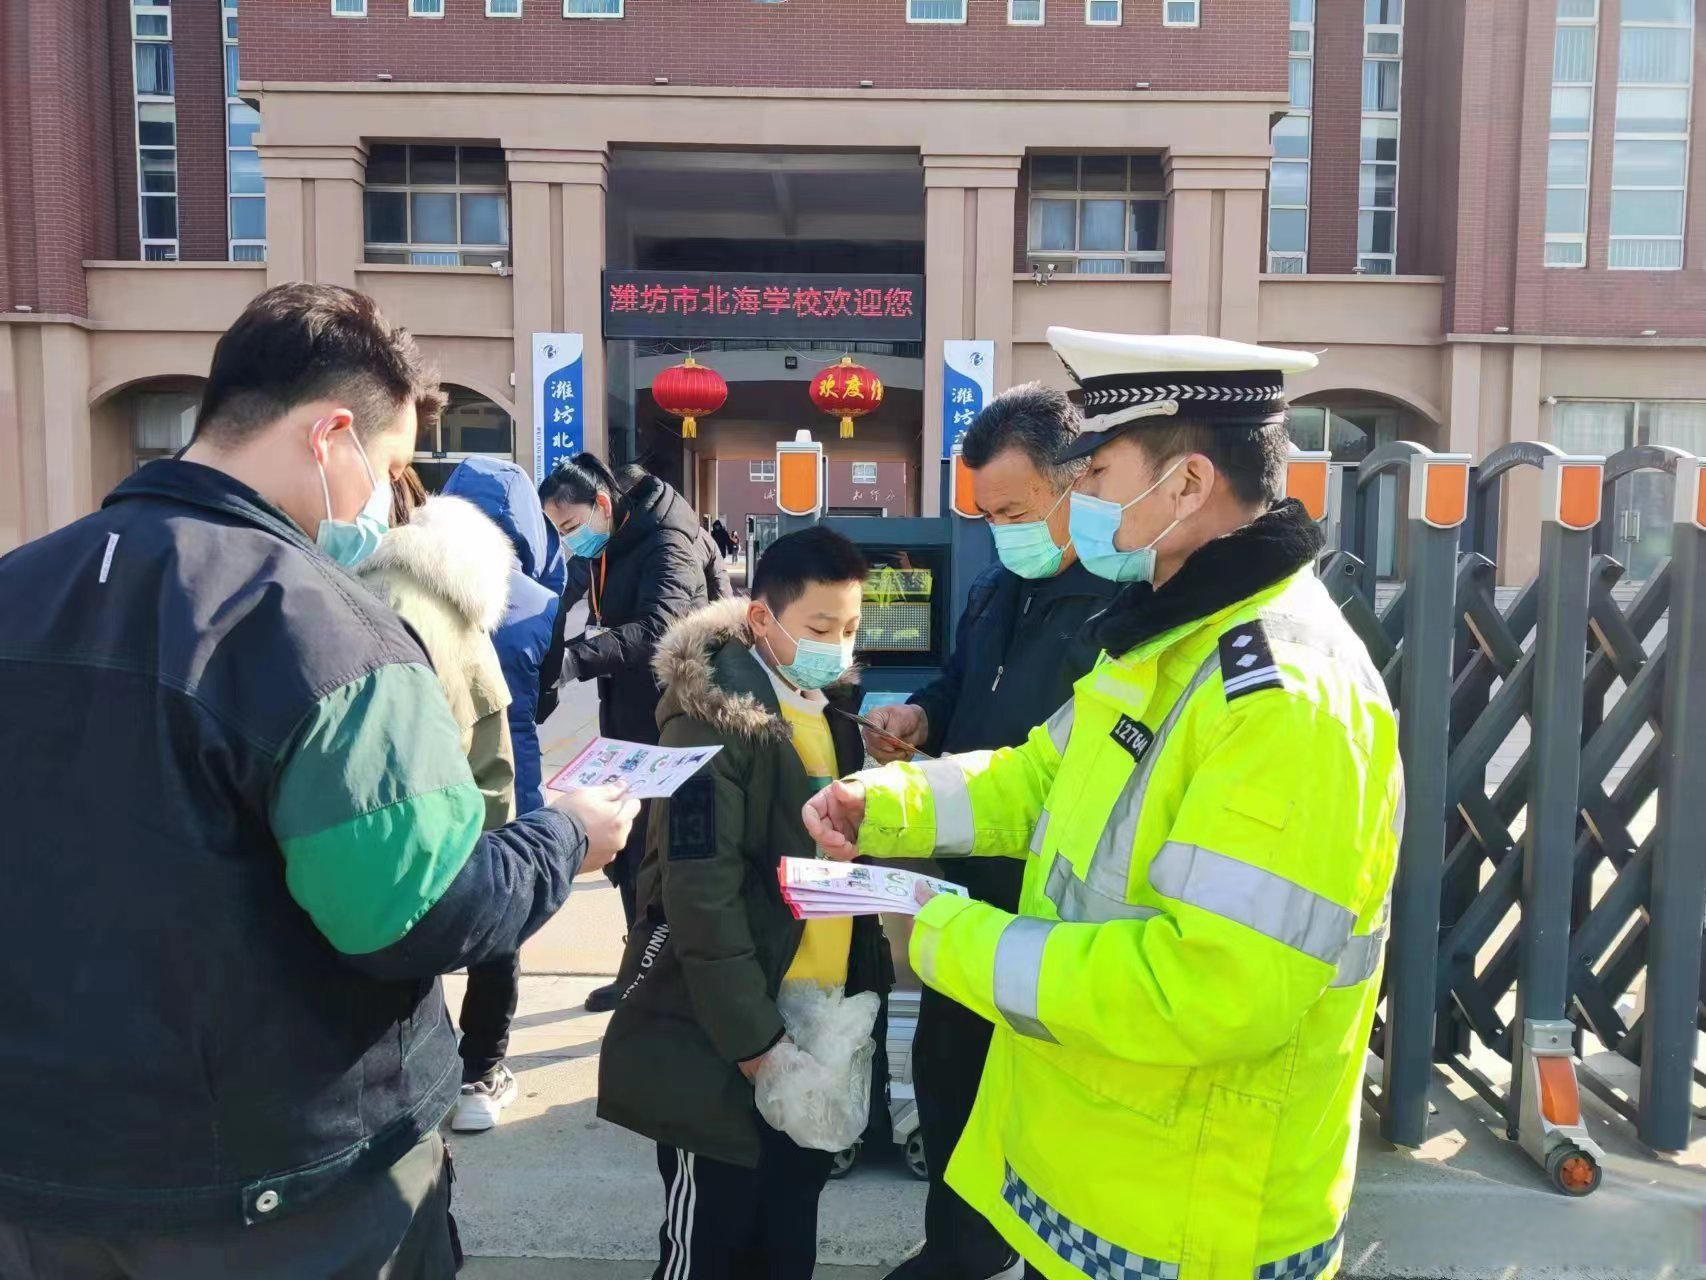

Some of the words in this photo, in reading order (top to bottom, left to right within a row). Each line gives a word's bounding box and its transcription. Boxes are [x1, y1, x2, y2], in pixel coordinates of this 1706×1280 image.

[609, 284, 914, 317] 潍坊市北海学校欢迎您
